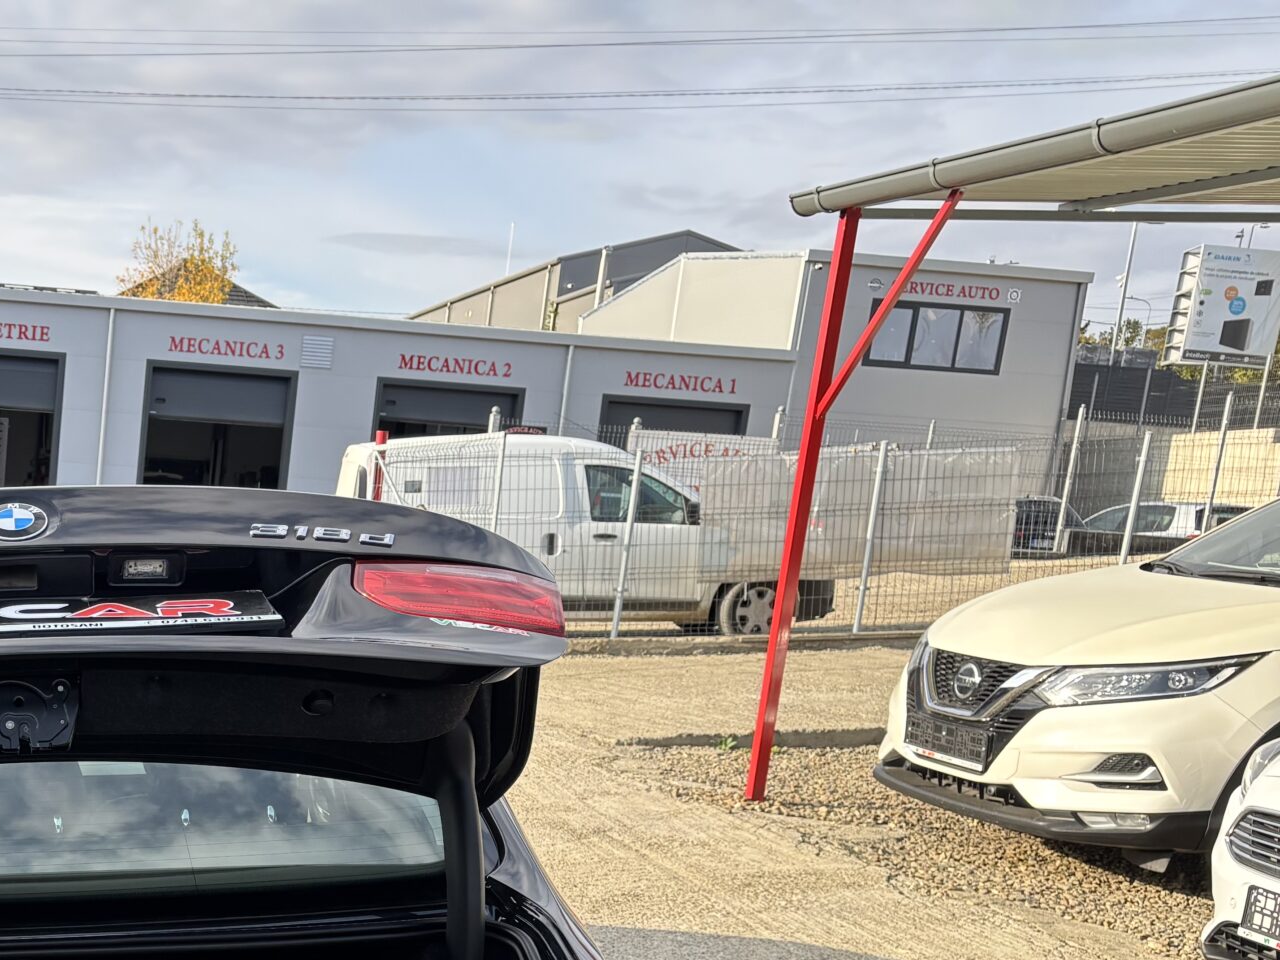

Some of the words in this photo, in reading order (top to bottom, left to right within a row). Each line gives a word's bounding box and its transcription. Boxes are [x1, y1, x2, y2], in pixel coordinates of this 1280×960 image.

[892, 278, 955, 298] RVICE
[957, 285, 1000, 301] AUTO
[168, 335, 271, 359] MECANICA
[275, 343, 285, 360] 3
[398, 353, 498, 377] MECANICA
[502, 362, 512, 378] 2
[624, 370, 724, 394] MECANICA
[728, 378, 737, 394] 1
